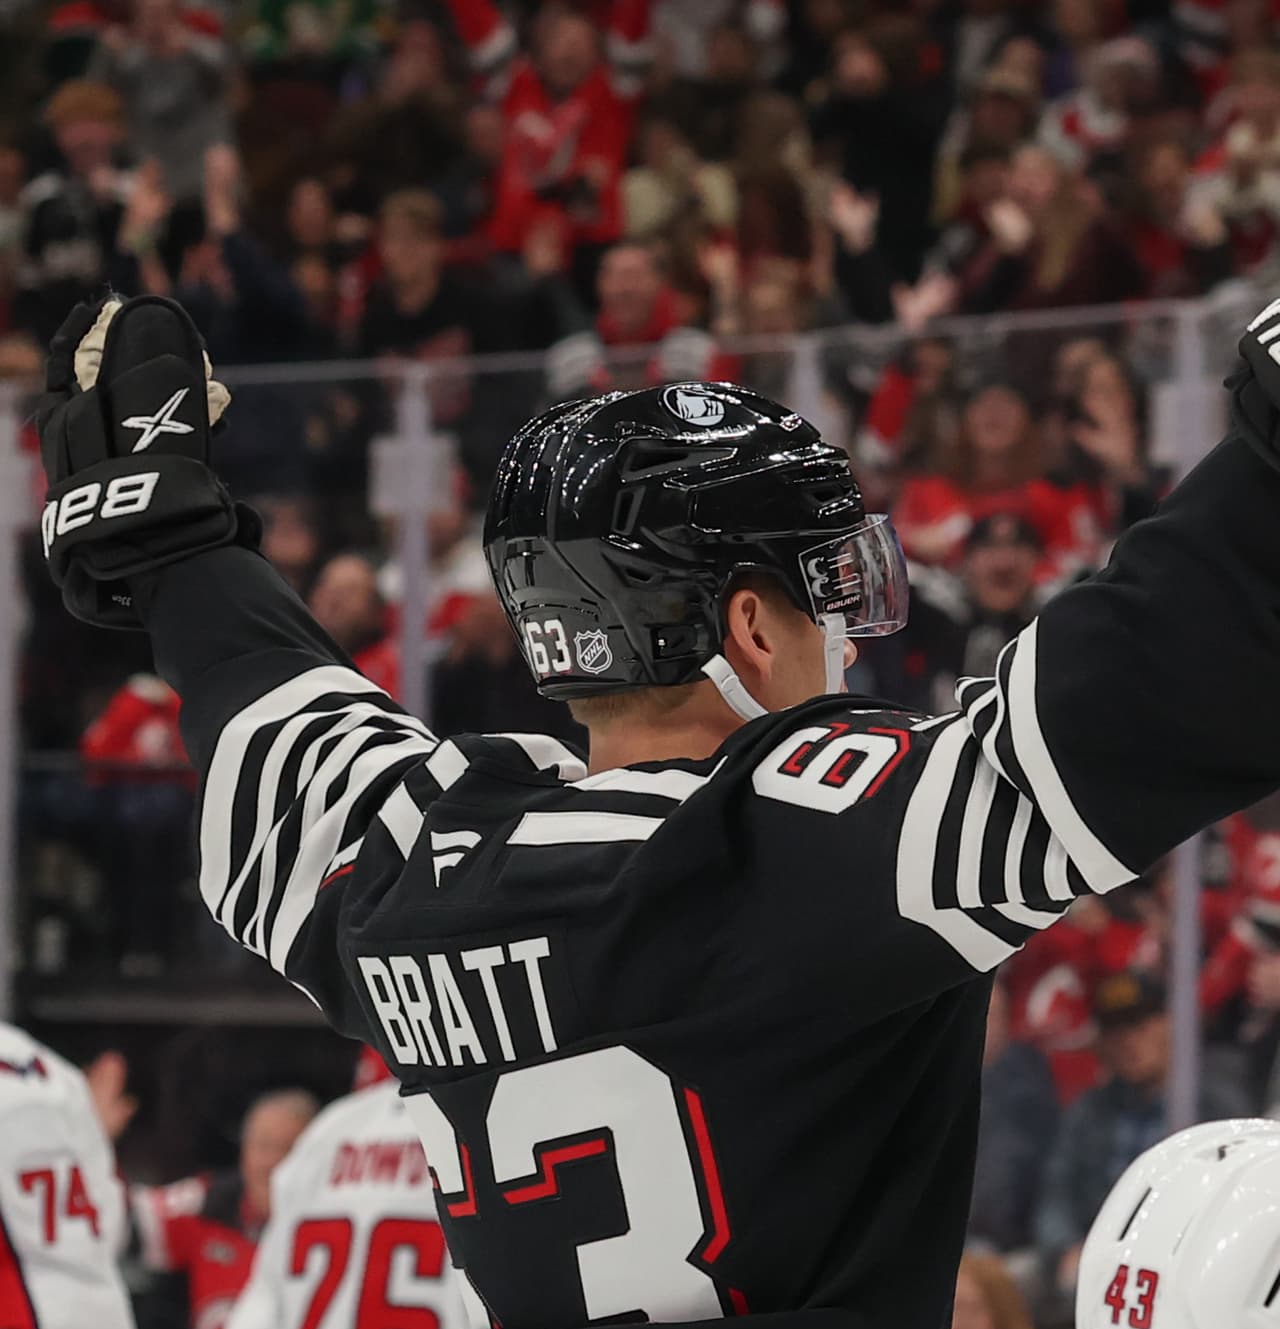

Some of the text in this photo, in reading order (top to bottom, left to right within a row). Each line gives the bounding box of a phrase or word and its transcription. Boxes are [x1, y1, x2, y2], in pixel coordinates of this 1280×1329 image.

[526, 618, 572, 674] 63
[752, 708, 925, 815] 6
[357, 937, 558, 1067] BRATT
[21, 1162, 100, 1247] 74
